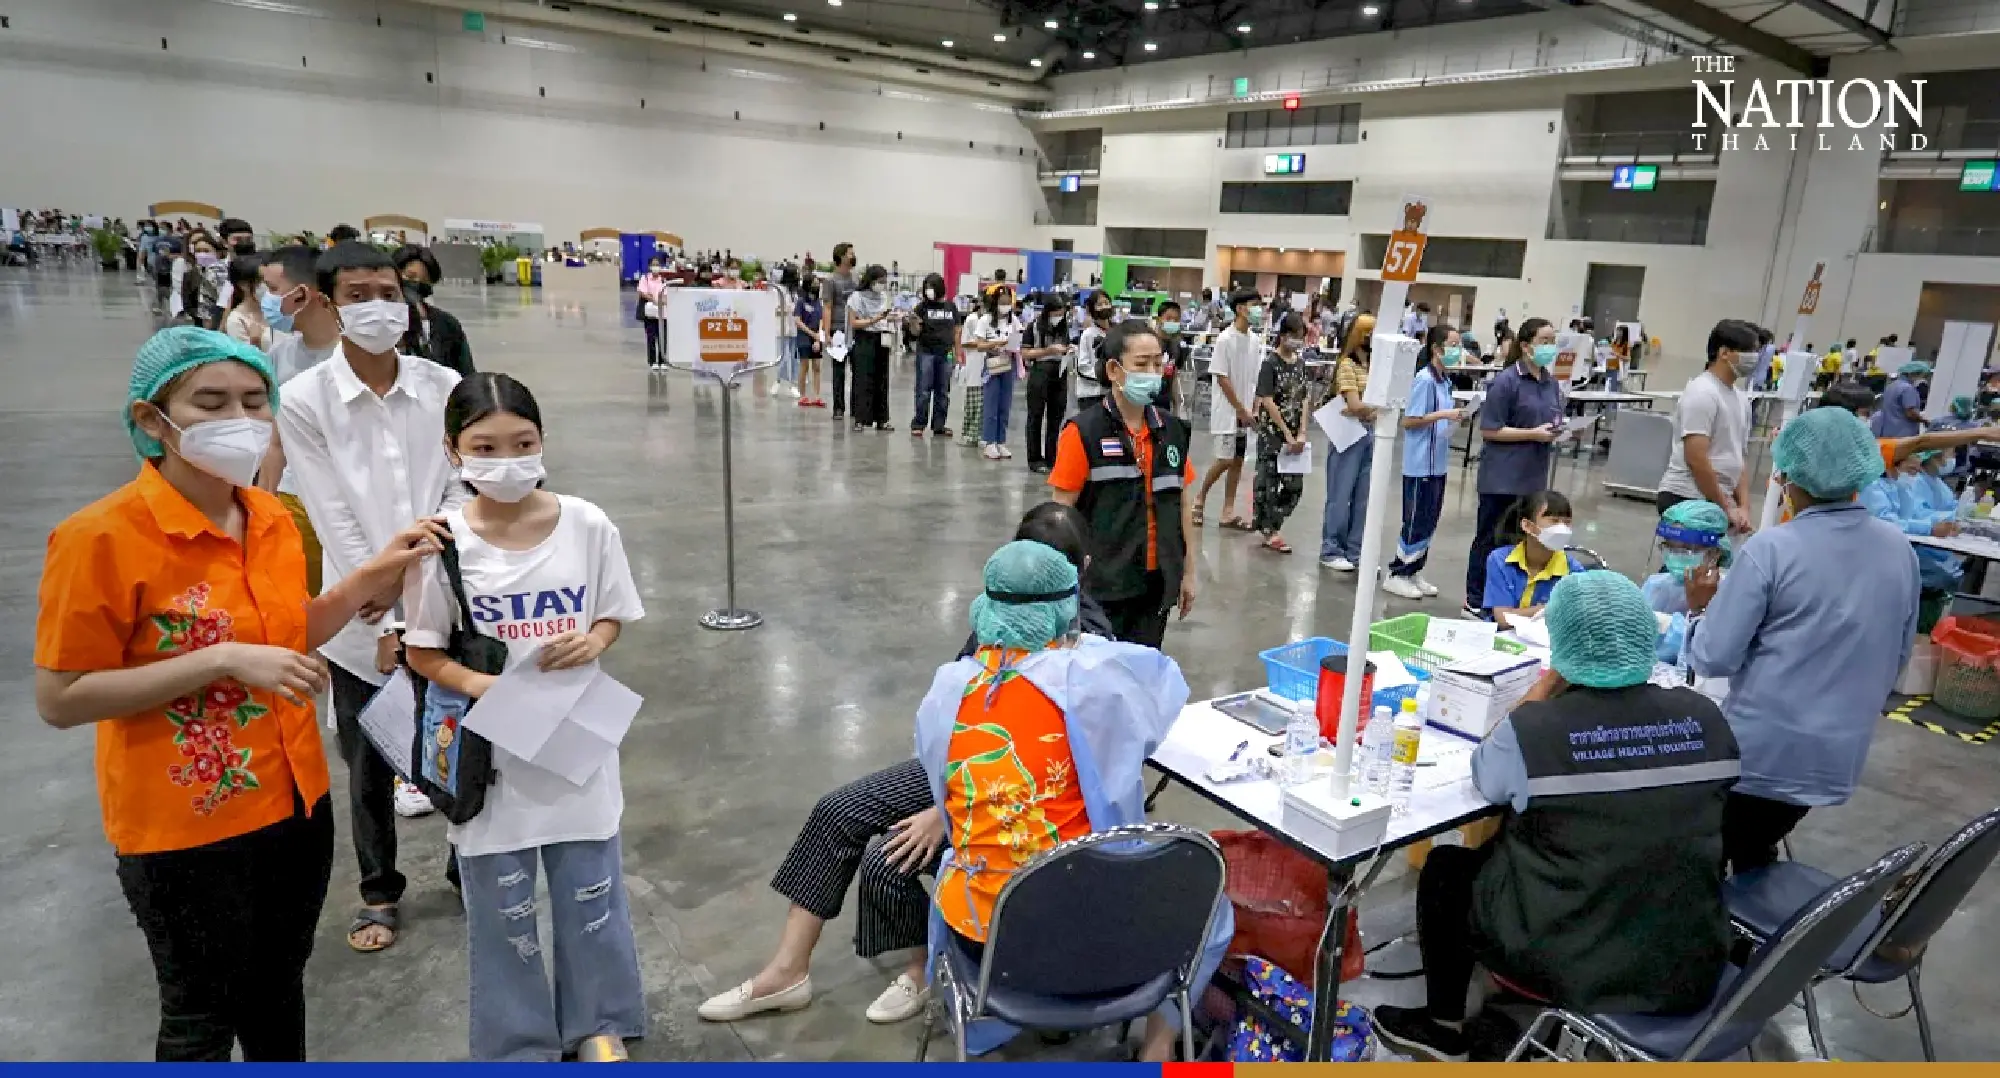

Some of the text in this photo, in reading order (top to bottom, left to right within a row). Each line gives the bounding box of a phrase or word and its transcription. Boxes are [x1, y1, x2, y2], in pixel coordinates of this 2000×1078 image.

[1386, 241, 1418, 273] 57
[472, 584, 586, 622] STAY
[497, 616, 576, 639] FOCUSED
[1572, 748, 1615, 761] VILLAGE
[1618, 745, 1655, 757] HEALTH
